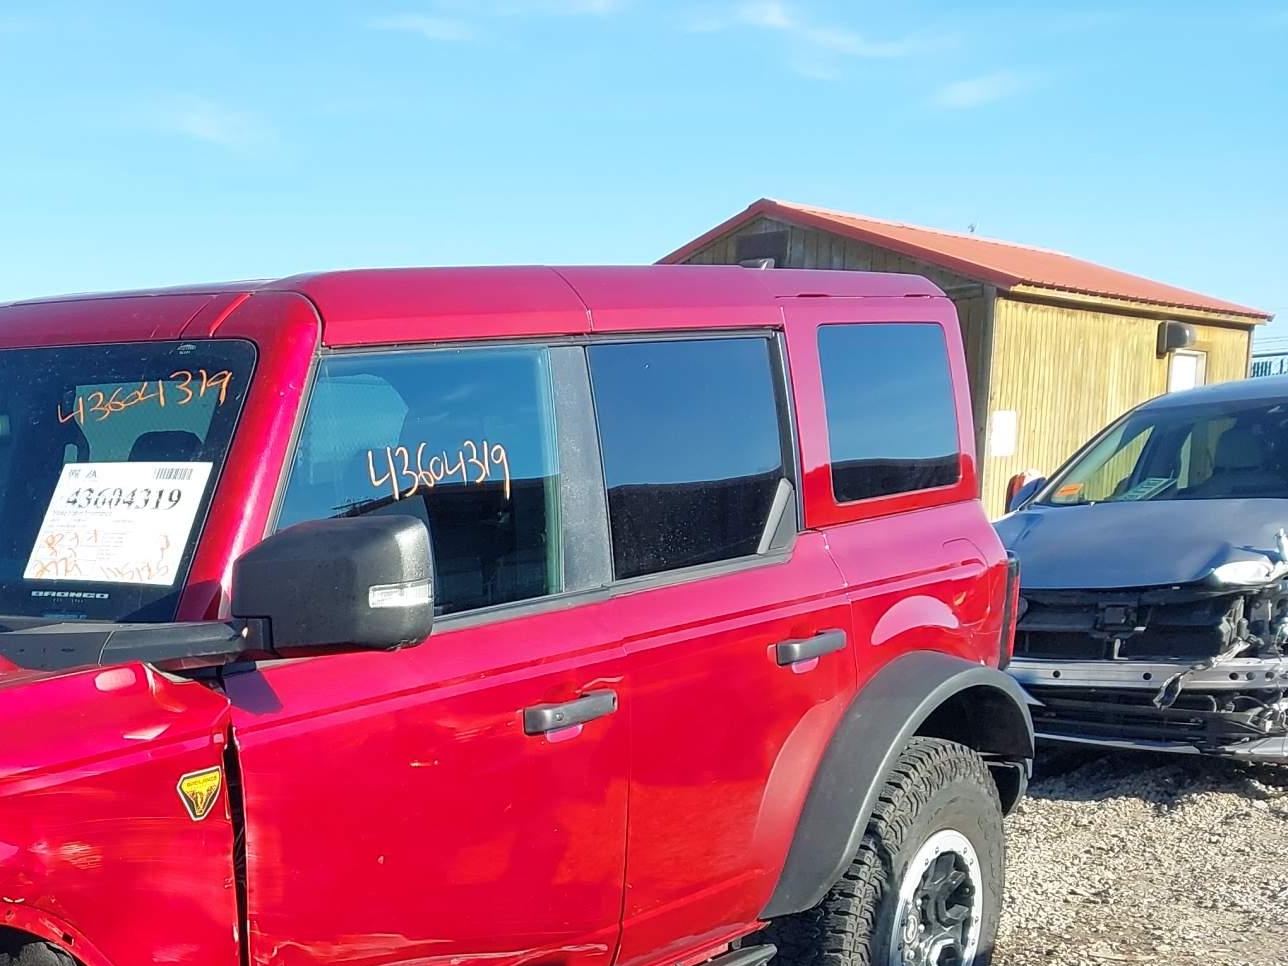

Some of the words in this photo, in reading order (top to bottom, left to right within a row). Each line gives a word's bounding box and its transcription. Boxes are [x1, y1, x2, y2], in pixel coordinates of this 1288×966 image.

[57, 369, 233, 425] 43604319
[367, 440, 511, 501] 43604319
[66, 487, 182, 510] 43604319
[31, 590, 110, 599] BRONCO
